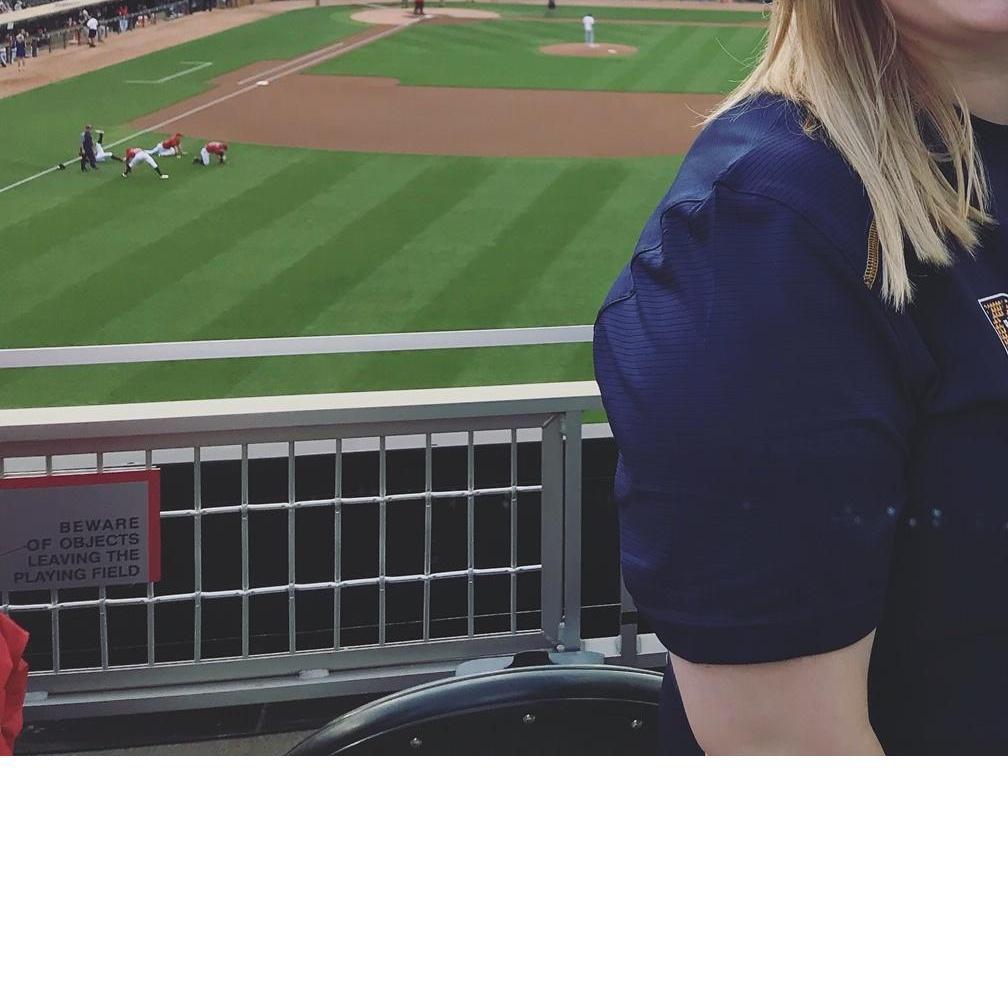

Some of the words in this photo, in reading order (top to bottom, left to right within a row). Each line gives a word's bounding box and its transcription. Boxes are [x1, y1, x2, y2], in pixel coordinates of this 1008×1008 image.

[60, 517, 140, 533] BEWARE
[26, 538, 51, 552] OF
[60, 533, 140, 549] OBJECTS
[28, 551, 100, 567] LEAVING
[107, 549, 140, 562] THE
[14, 568, 86, 584] PLAYING
[92, 565, 140, 579] FIELD
